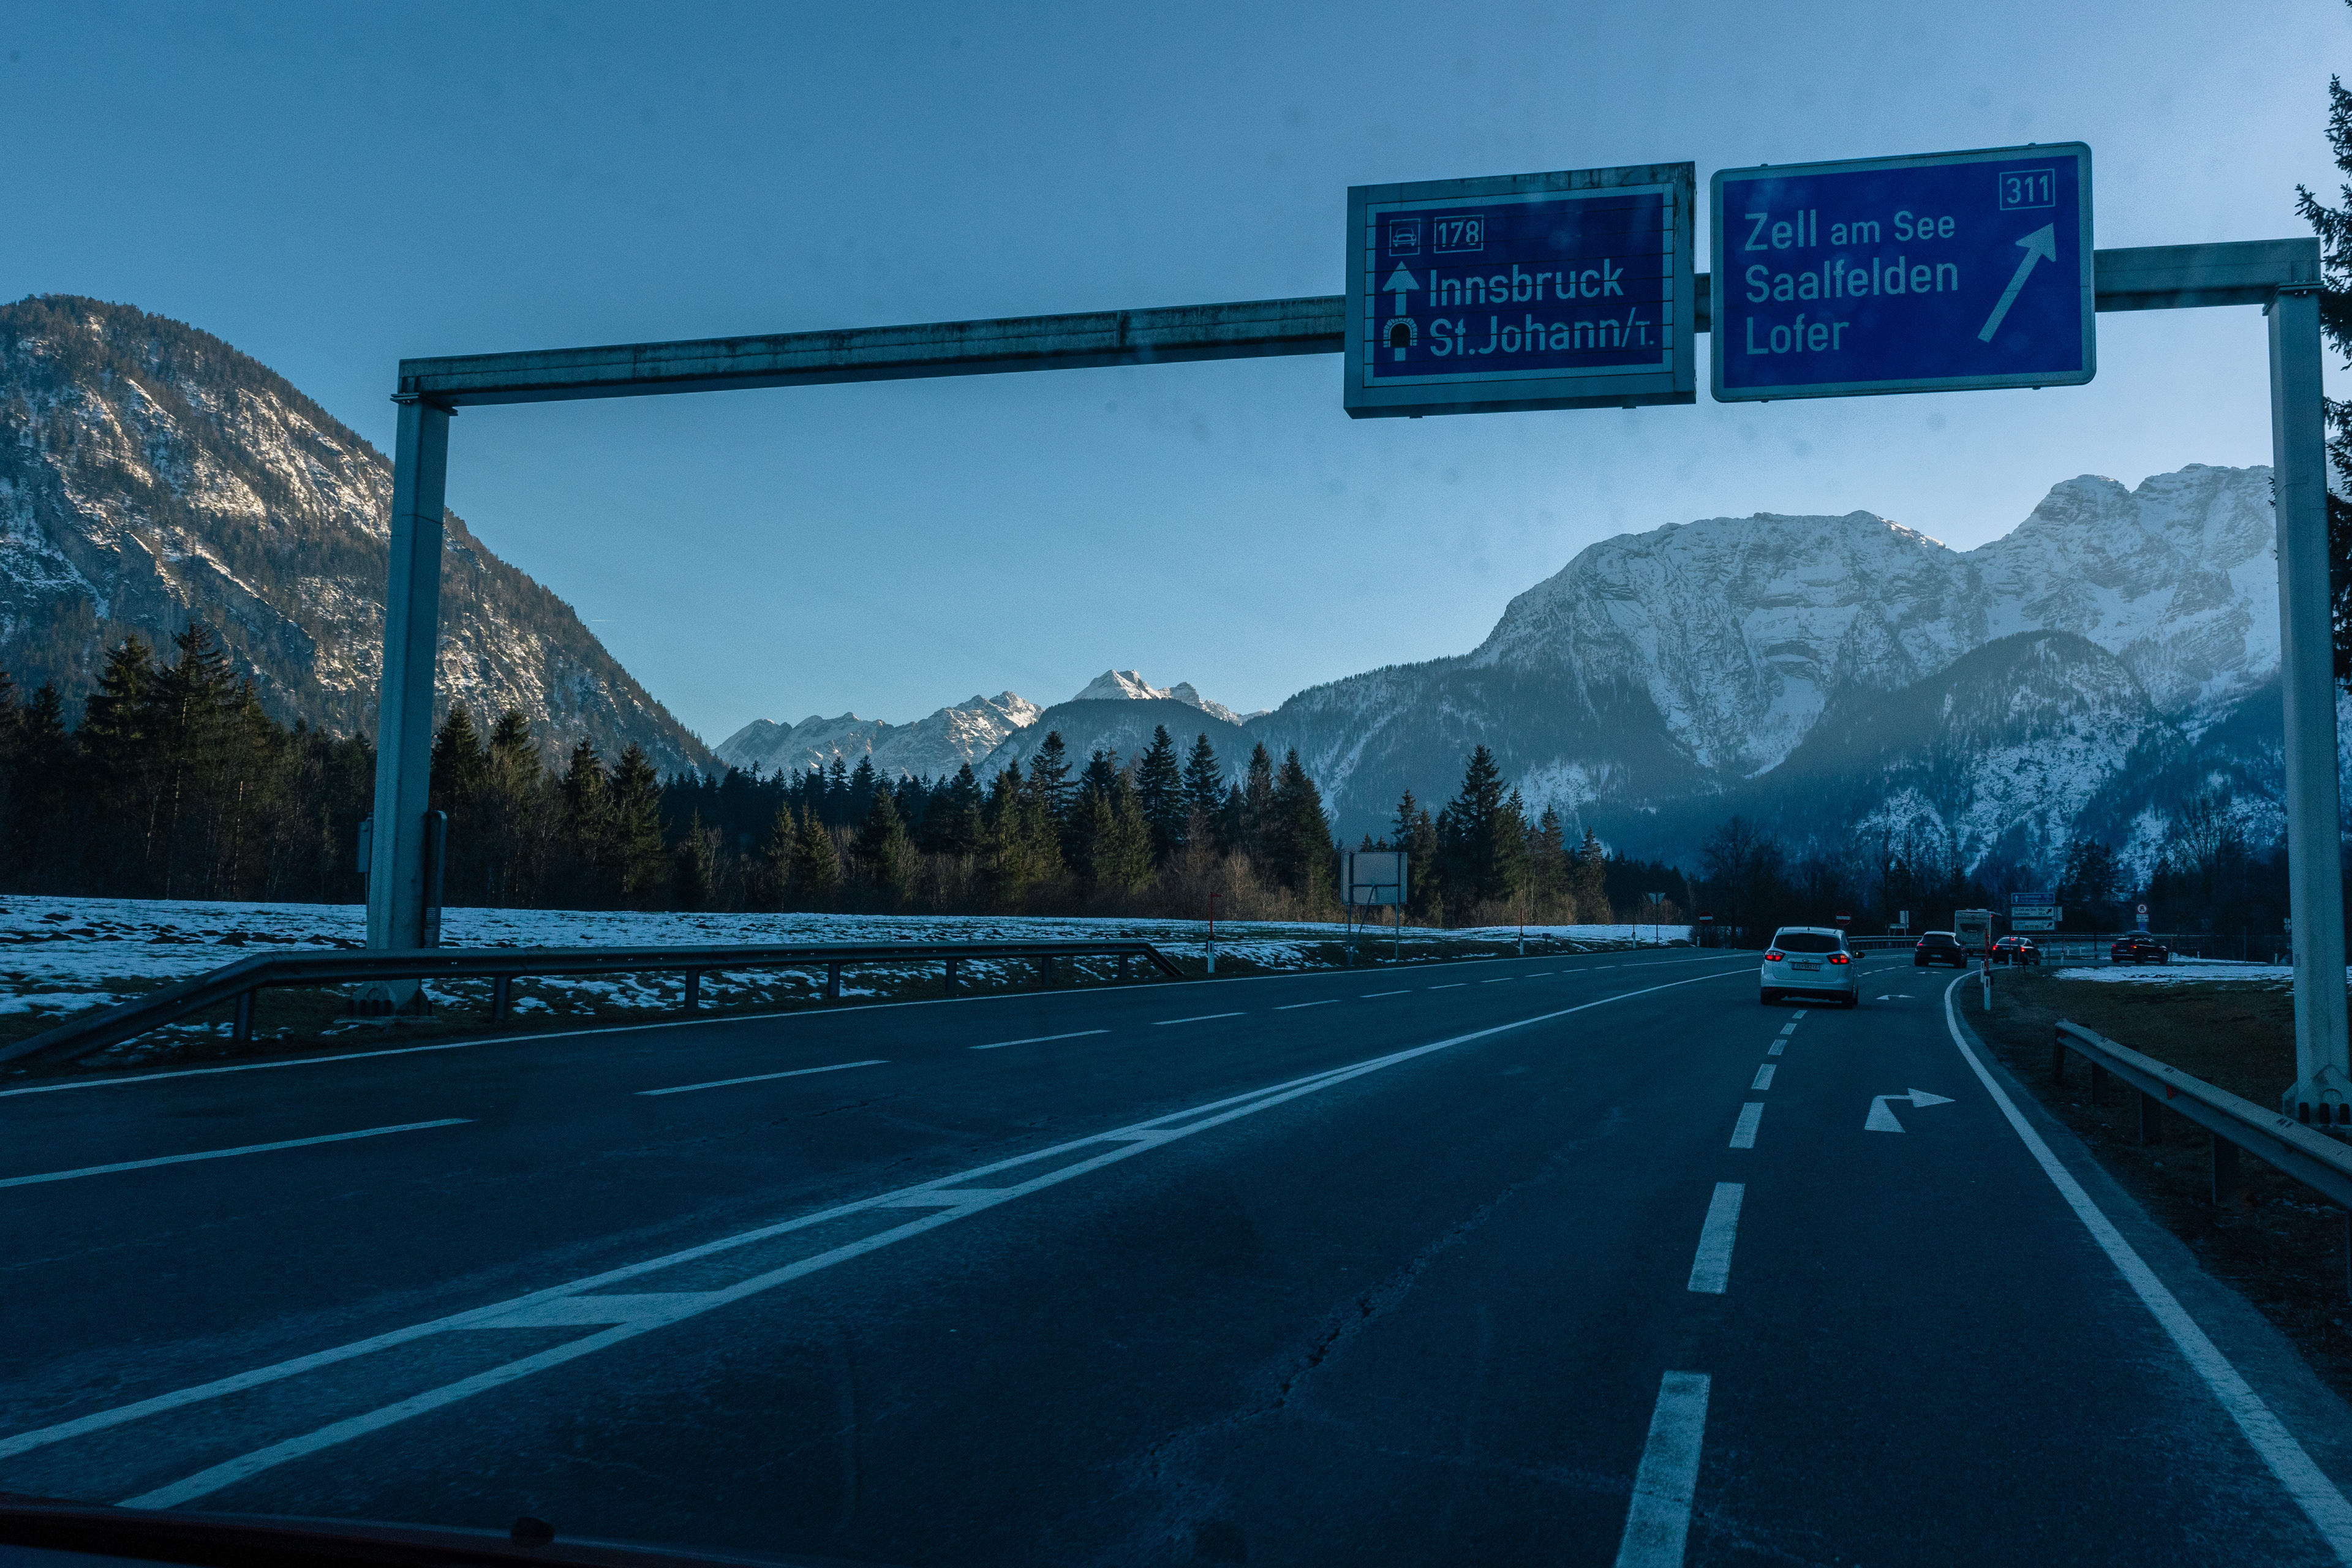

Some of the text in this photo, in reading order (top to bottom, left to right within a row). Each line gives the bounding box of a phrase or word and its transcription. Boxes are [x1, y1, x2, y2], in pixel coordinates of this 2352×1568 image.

[2005, 175, 2050, 204] 311
[1438, 220, 1480, 247] 178
[1744, 209, 1956, 251] Zell am See
[1430, 258, 1624, 307] Innsbruck
[1745, 255, 1958, 303] Saalfelden
[1746, 314, 1850, 355] Lofer
